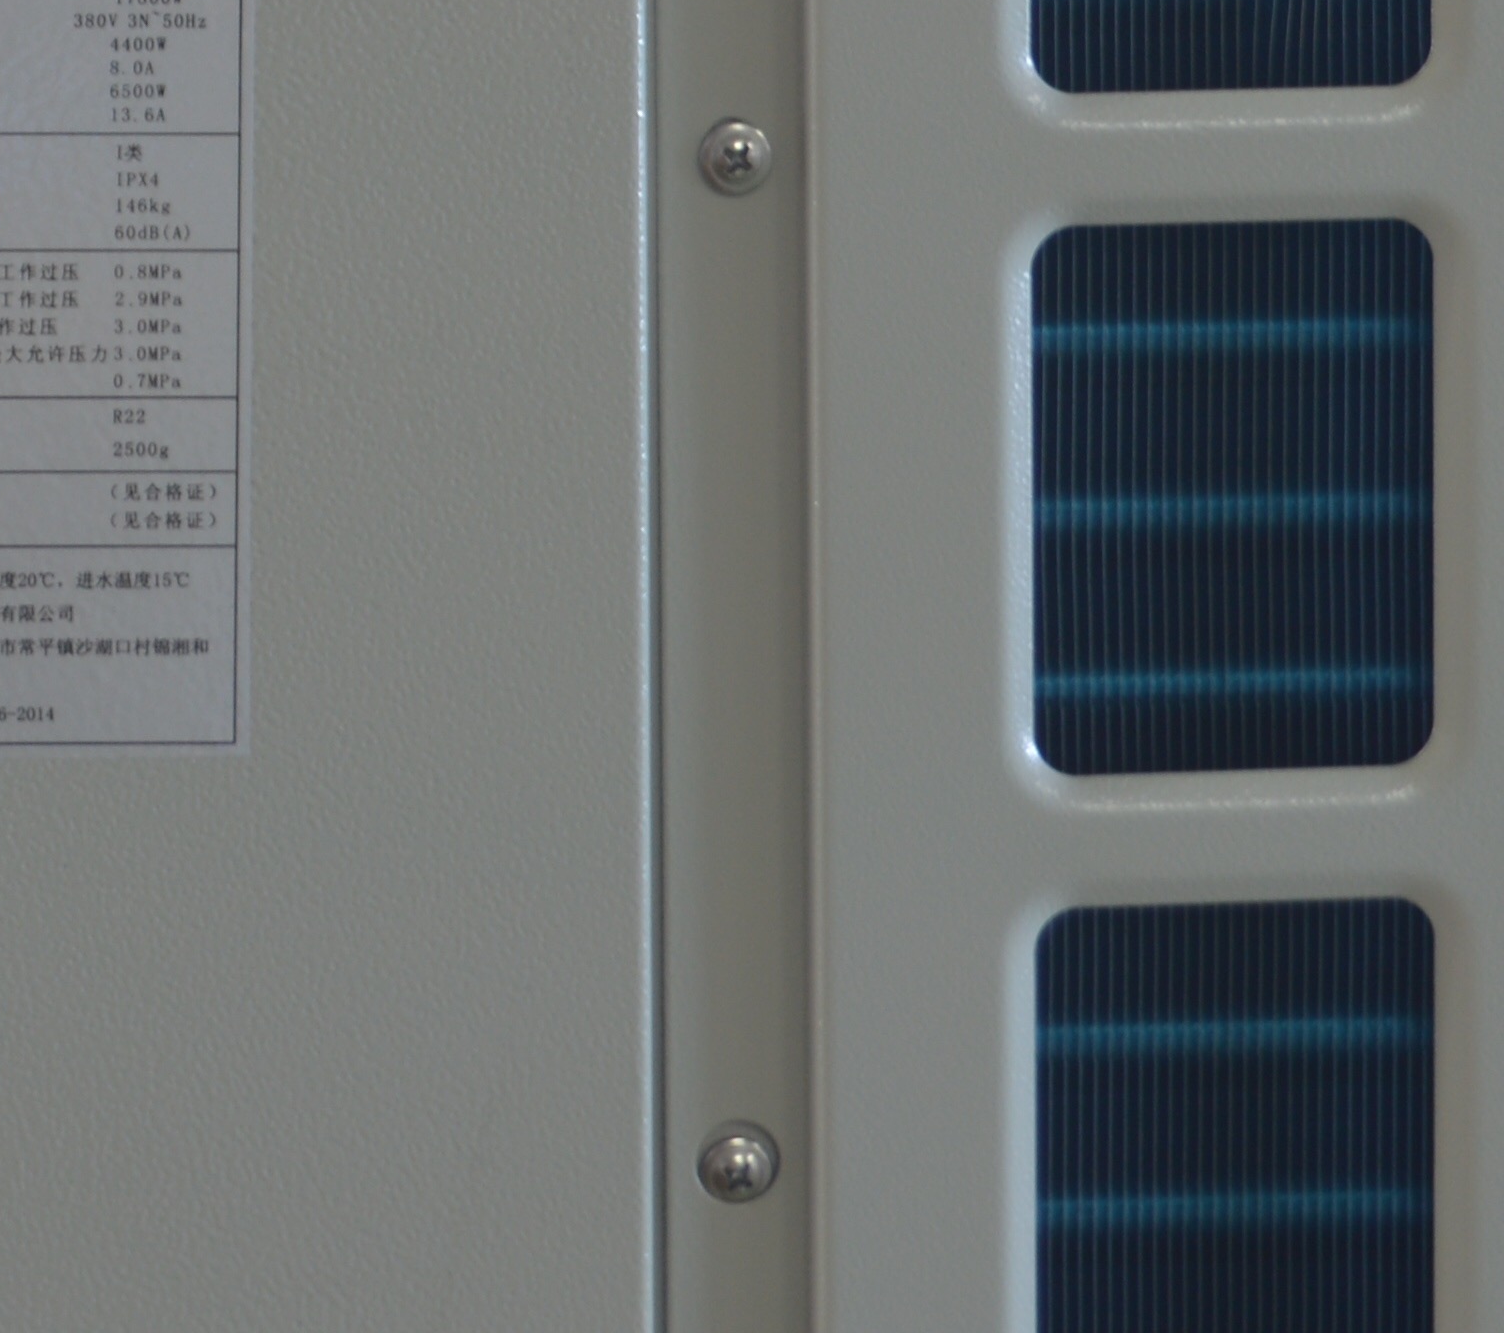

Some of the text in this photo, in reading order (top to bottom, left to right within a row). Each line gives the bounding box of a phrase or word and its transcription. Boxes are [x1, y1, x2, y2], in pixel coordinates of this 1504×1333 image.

[73, 13, 118, 29] 380V
[110, 36, 167, 52] 4400W
[109, 60, 155, 76] 8.0A
[109, 83, 166, 99] 6500W
[112, 107, 166, 123] 13.6A
[117, 171, 159, 187] IPX4
[116, 197, 171, 215] 146kg
[114, 224, 191, 241] 60dB(A)
[113, 263, 182, 280] 0.8MPa
[115, 291, 183, 307] 2.9MPa
[114, 318, 182, 334] 3.0MPa
[114, 345, 182, 362] 3.0MPa
[113, 373, 182, 389] 0.7MPa
[112, 408, 146, 425] R22
[112, 441, 169, 460] 2500g
